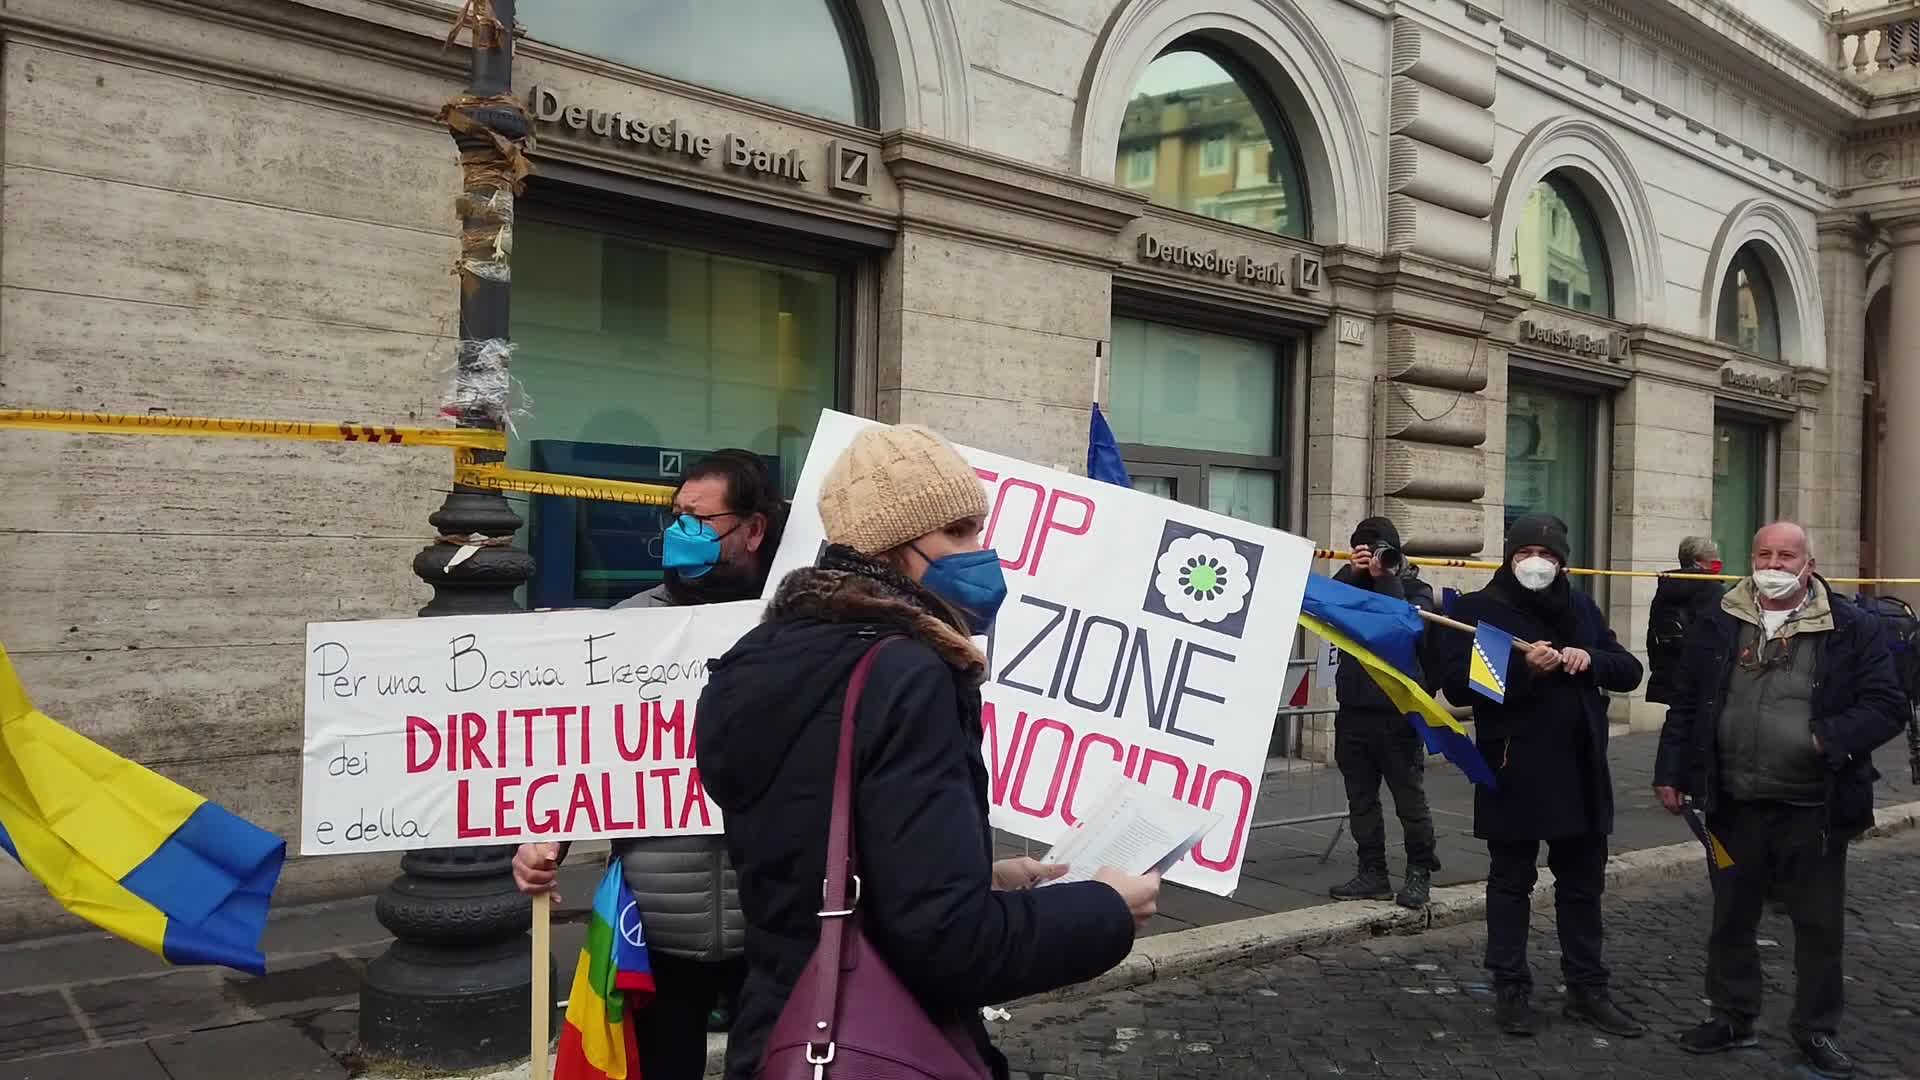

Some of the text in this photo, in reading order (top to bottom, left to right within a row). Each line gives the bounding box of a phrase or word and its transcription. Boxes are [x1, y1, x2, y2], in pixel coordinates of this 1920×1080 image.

[532, 84, 809, 182] Deutsche Bank
[1138, 233, 1289, 286] Deutsche Bank
[1521, 320, 1580, 349] Deutsche
[313, 641, 366, 700] Per
[377, 674, 426, 697] una
[328, 743, 368, 776] dei
[405, 705, 591, 774] DIRITTI
[316, 819, 336, 844] e
[345, 807, 429, 842] della
